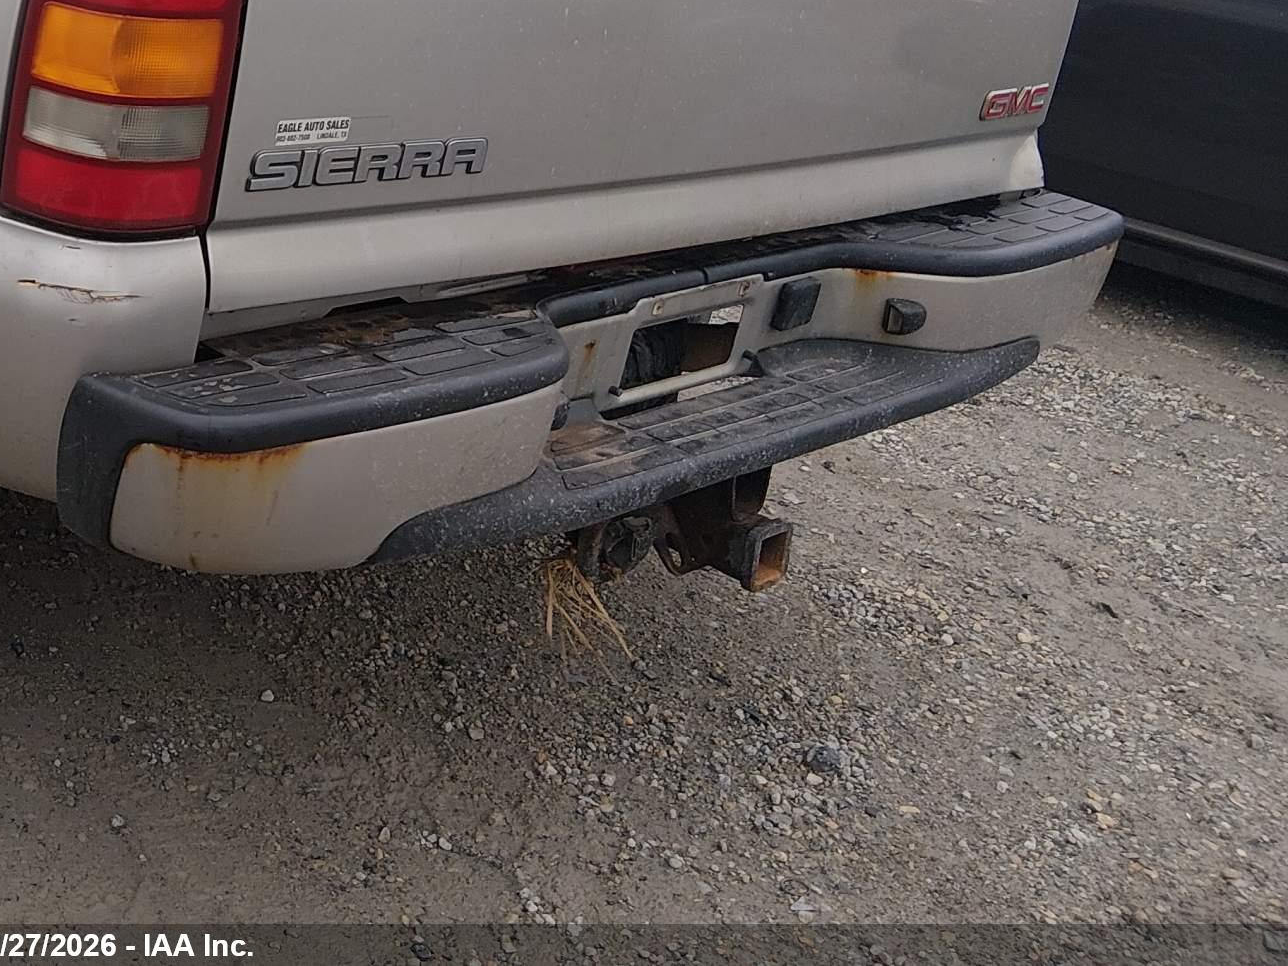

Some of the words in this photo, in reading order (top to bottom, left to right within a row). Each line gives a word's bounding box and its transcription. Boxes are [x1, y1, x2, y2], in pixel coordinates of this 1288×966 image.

[979, 82, 1049, 121] GMC
[277, 122, 303, 133] EAGLE
[304, 121, 325, 132] AUTO
[326, 119, 350, 130] SALES
[245, 137, 489, 192] SIERRA
